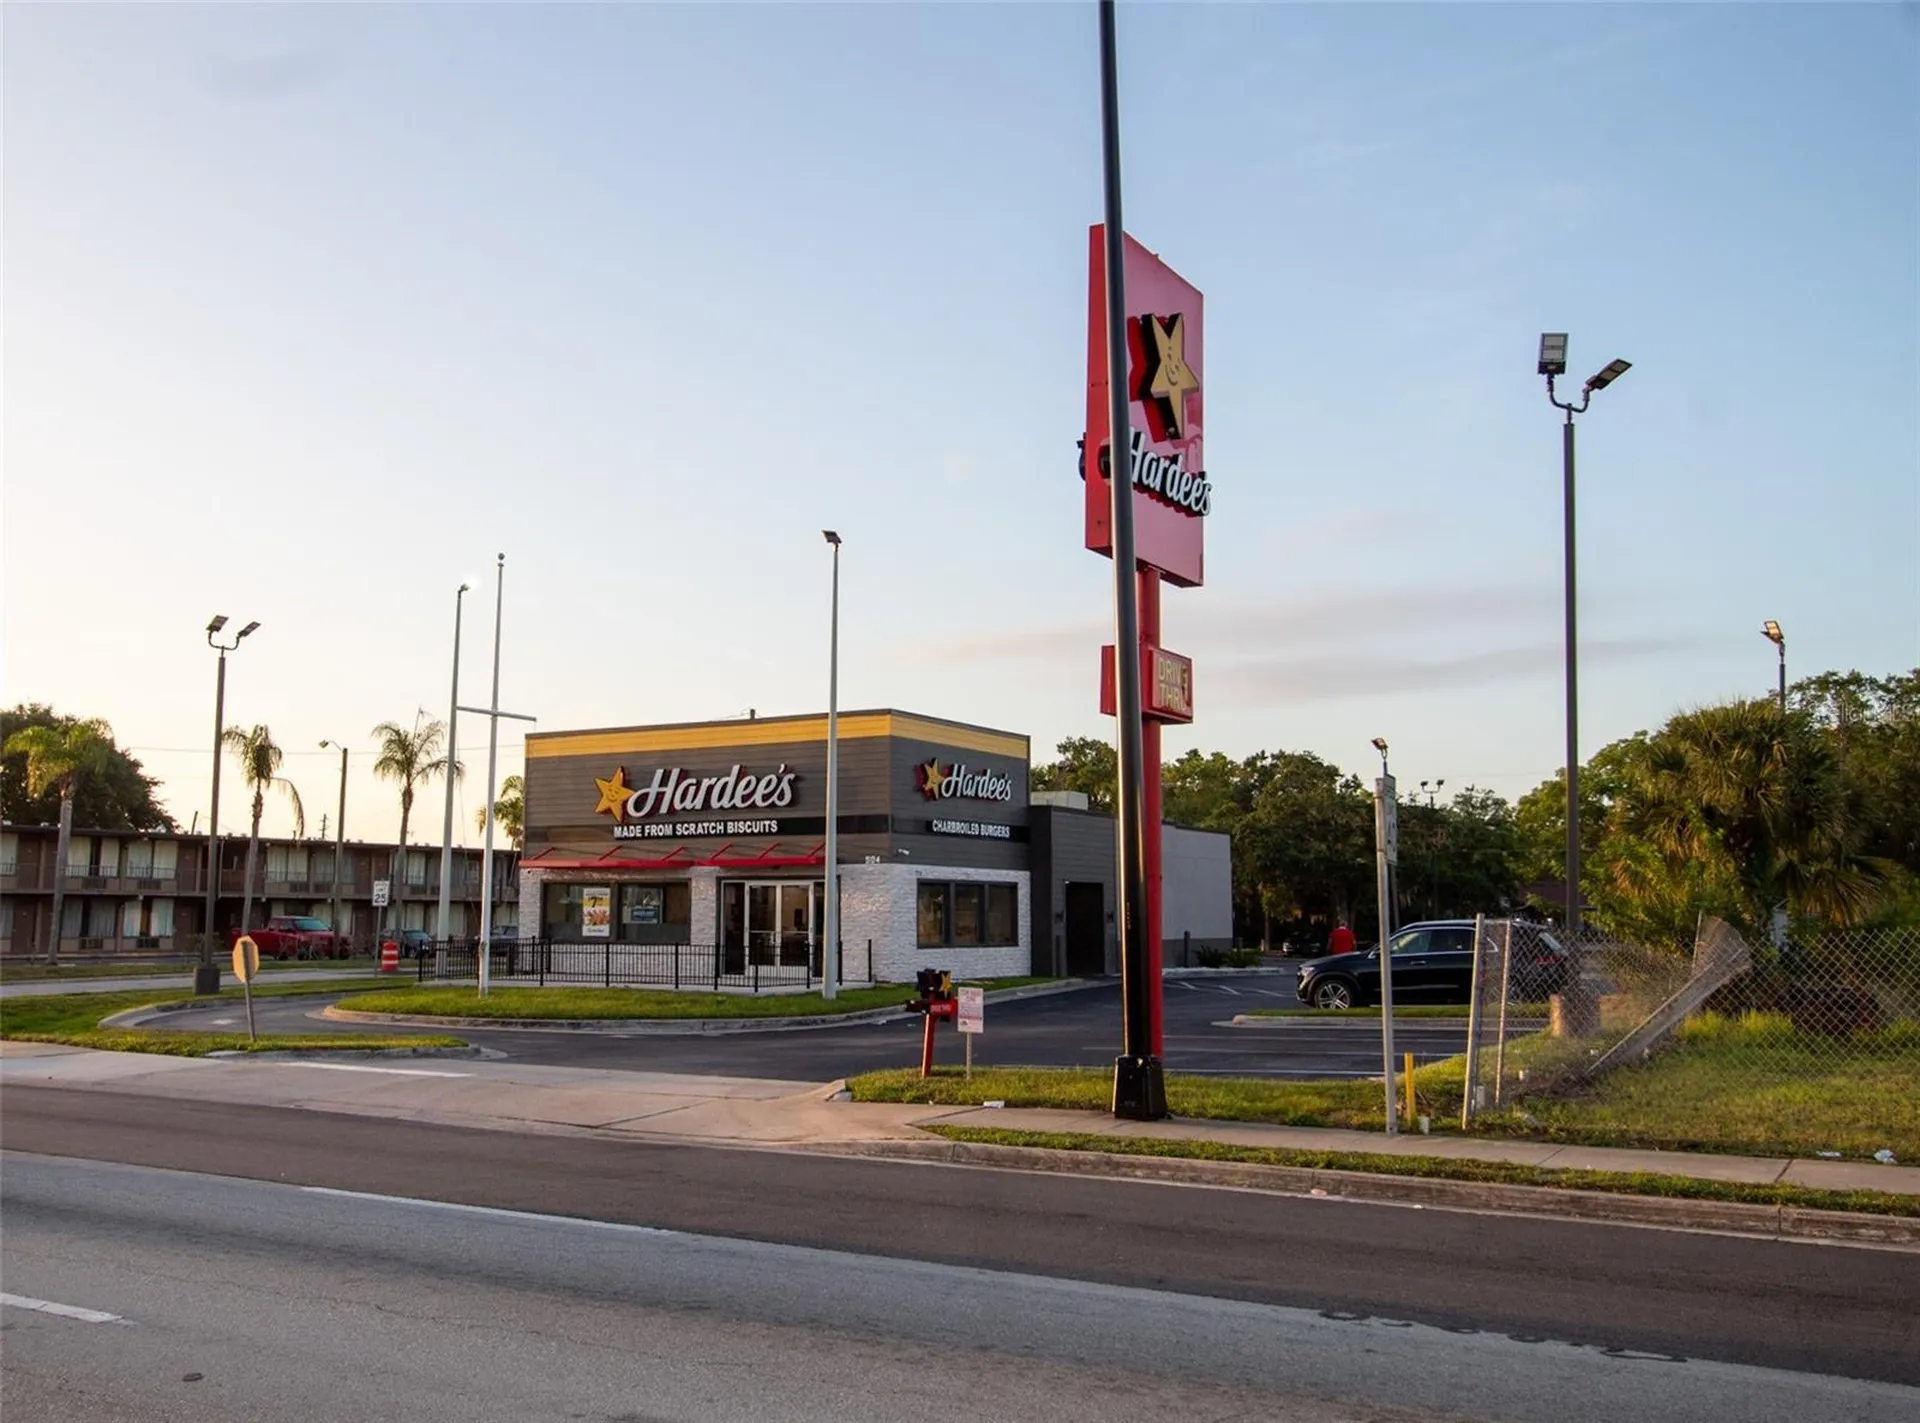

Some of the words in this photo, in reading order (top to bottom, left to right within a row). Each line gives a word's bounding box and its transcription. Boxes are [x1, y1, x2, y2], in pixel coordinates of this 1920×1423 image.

[626, 763, 796, 818] Hardee's
[941, 763, 1012, 801] Hardee's
[613, 825, 642, 838] MADE
[644, 824, 673, 837] FROM
[675, 822, 724, 836] SCRATCH
[727, 820, 778, 834] BISCUITS
[932, 819, 980, 835] CHARBROILED
[980, 823, 1010, 838] BURGERS
[374, 893, 387, 903] 25
